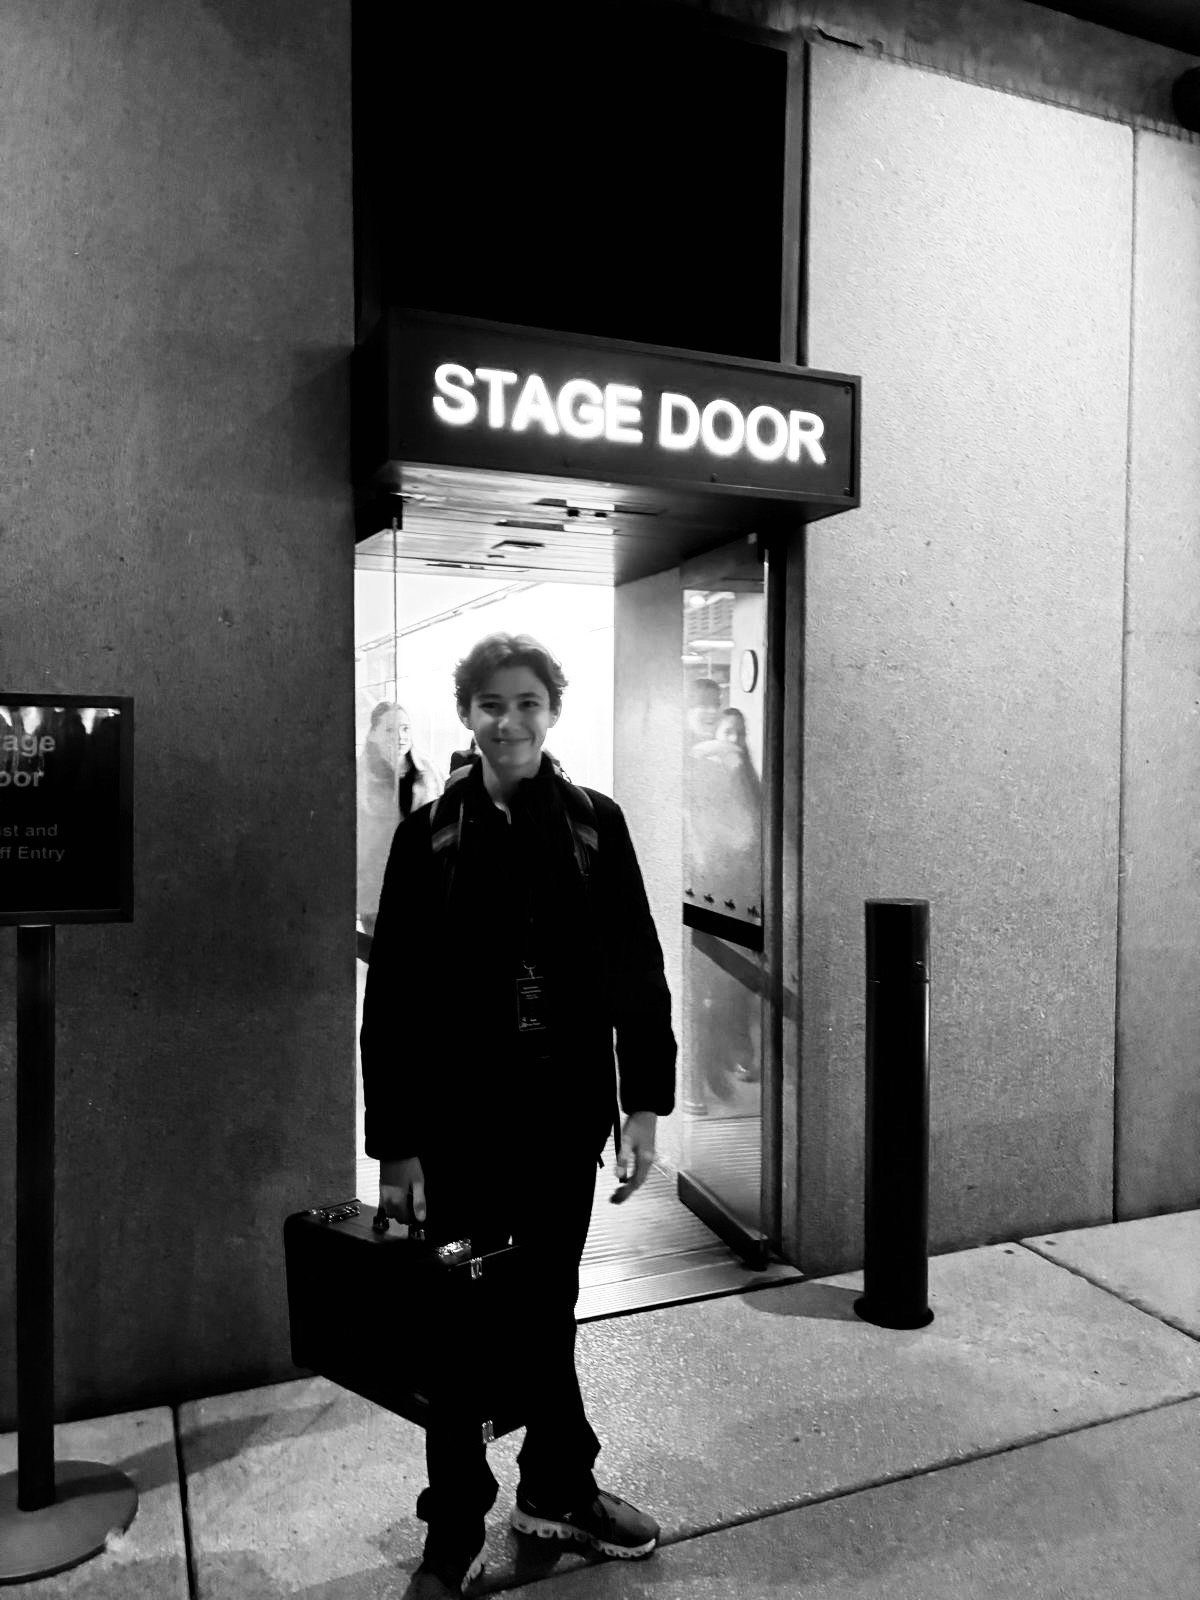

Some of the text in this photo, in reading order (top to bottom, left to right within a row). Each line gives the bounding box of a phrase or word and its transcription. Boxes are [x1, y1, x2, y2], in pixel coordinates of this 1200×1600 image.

[432, 363, 827, 464] STAGE DOOR
[0, 824, 58, 837] st and
[18, 846, 65, 862] Entry
